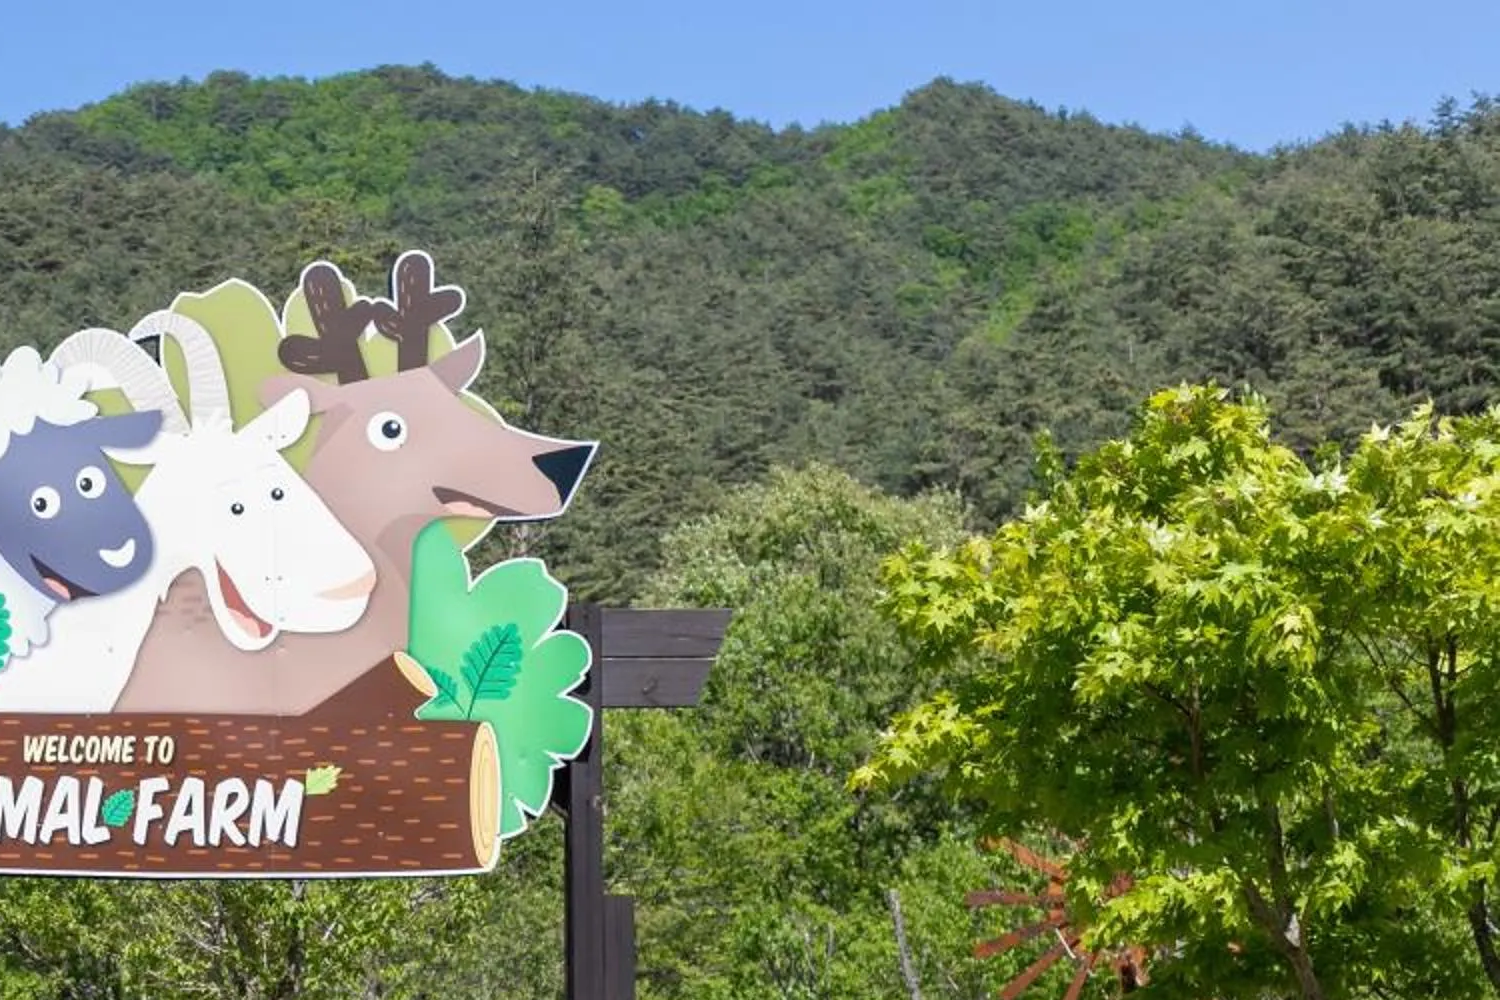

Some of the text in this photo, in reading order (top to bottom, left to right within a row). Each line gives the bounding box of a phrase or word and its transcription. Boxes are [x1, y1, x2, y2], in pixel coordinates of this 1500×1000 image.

[23, 735, 175, 764] WELCOME TO
[133, 777, 304, 848] FARM
